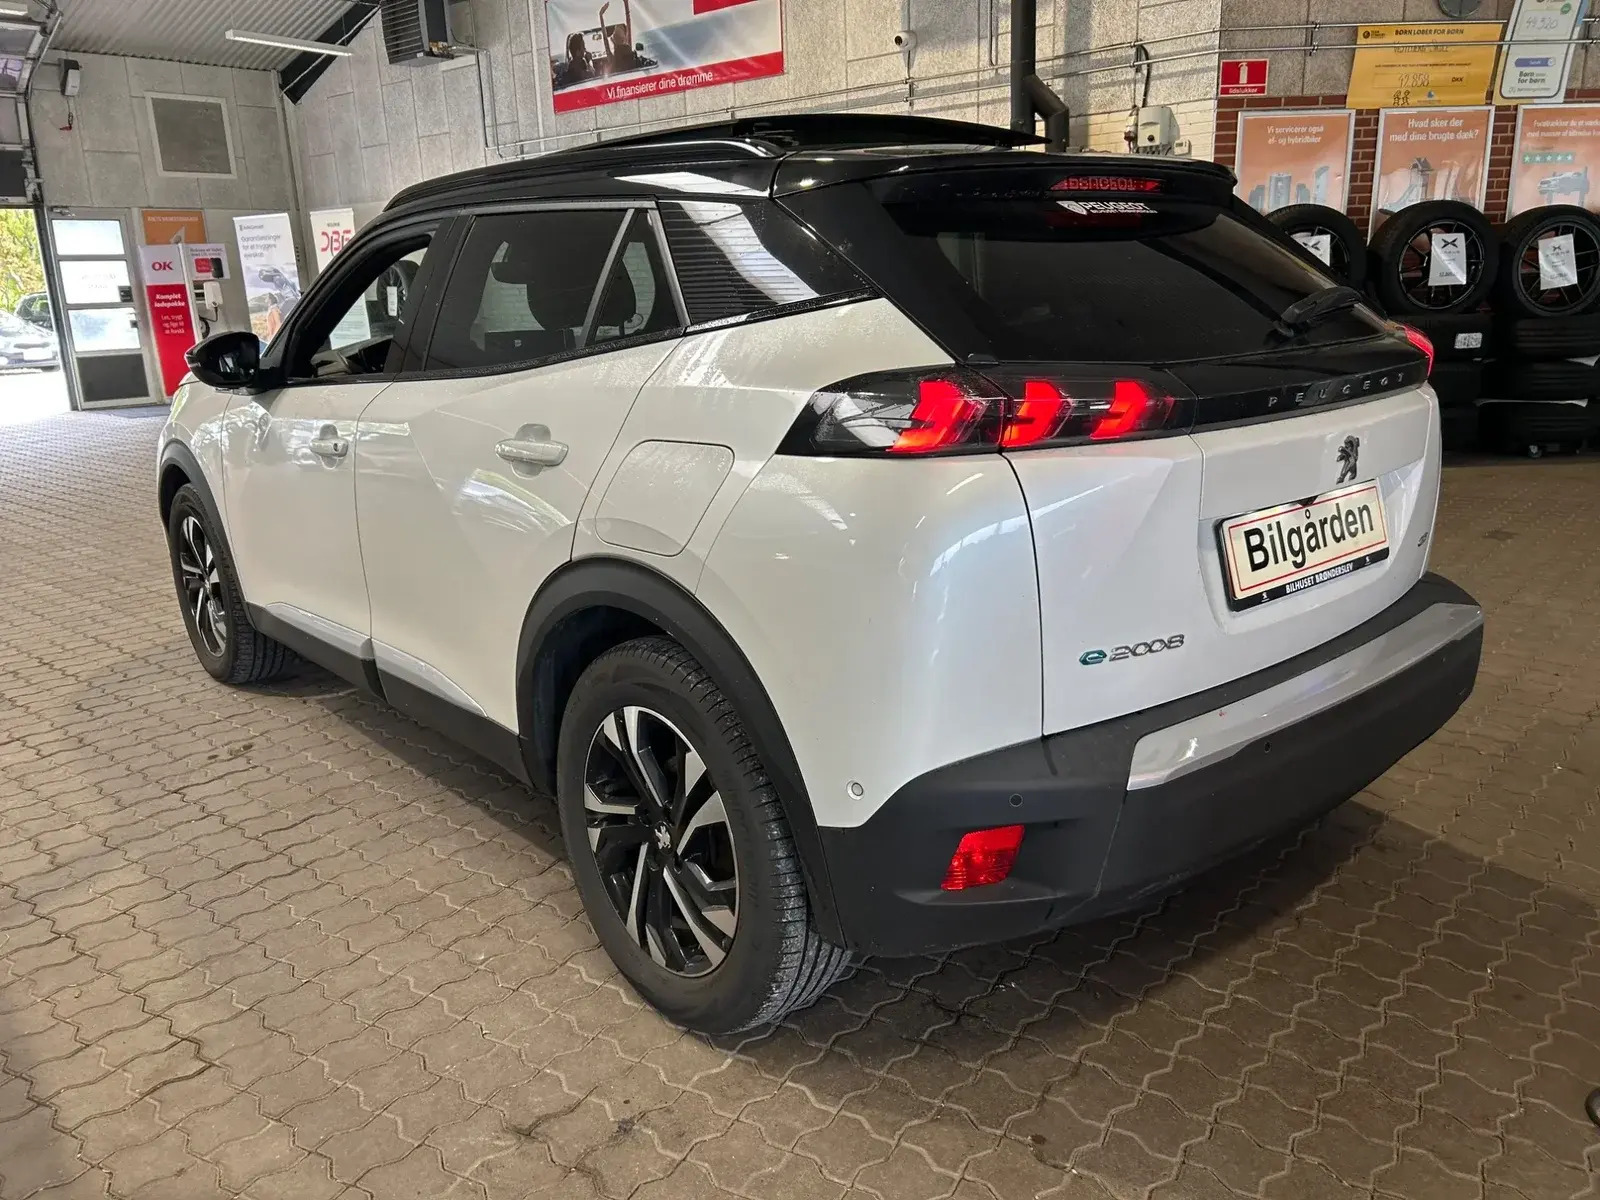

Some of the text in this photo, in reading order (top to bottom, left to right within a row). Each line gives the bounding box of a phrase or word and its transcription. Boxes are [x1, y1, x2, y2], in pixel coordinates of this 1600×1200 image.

[607, 71, 713, 99] Vi finansierer dine drømme
[1267, 124, 1324, 134] Vi servicerer også
[1408, 117, 1464, 129] Hvad sker der
[1389, 129, 1479, 142] med dine brugte dæk?
[1078, 201, 1151, 210] PEUGEOT
[152, 261, 174, 271] OK
[156, 293, 182, 302] Komplet
[1268, 372, 1405, 407] PEUGEOT
[1243, 502, 1375, 573] Bilgården
[1285, 562, 1354, 595] BILHUSET BRØNDERSLEV
